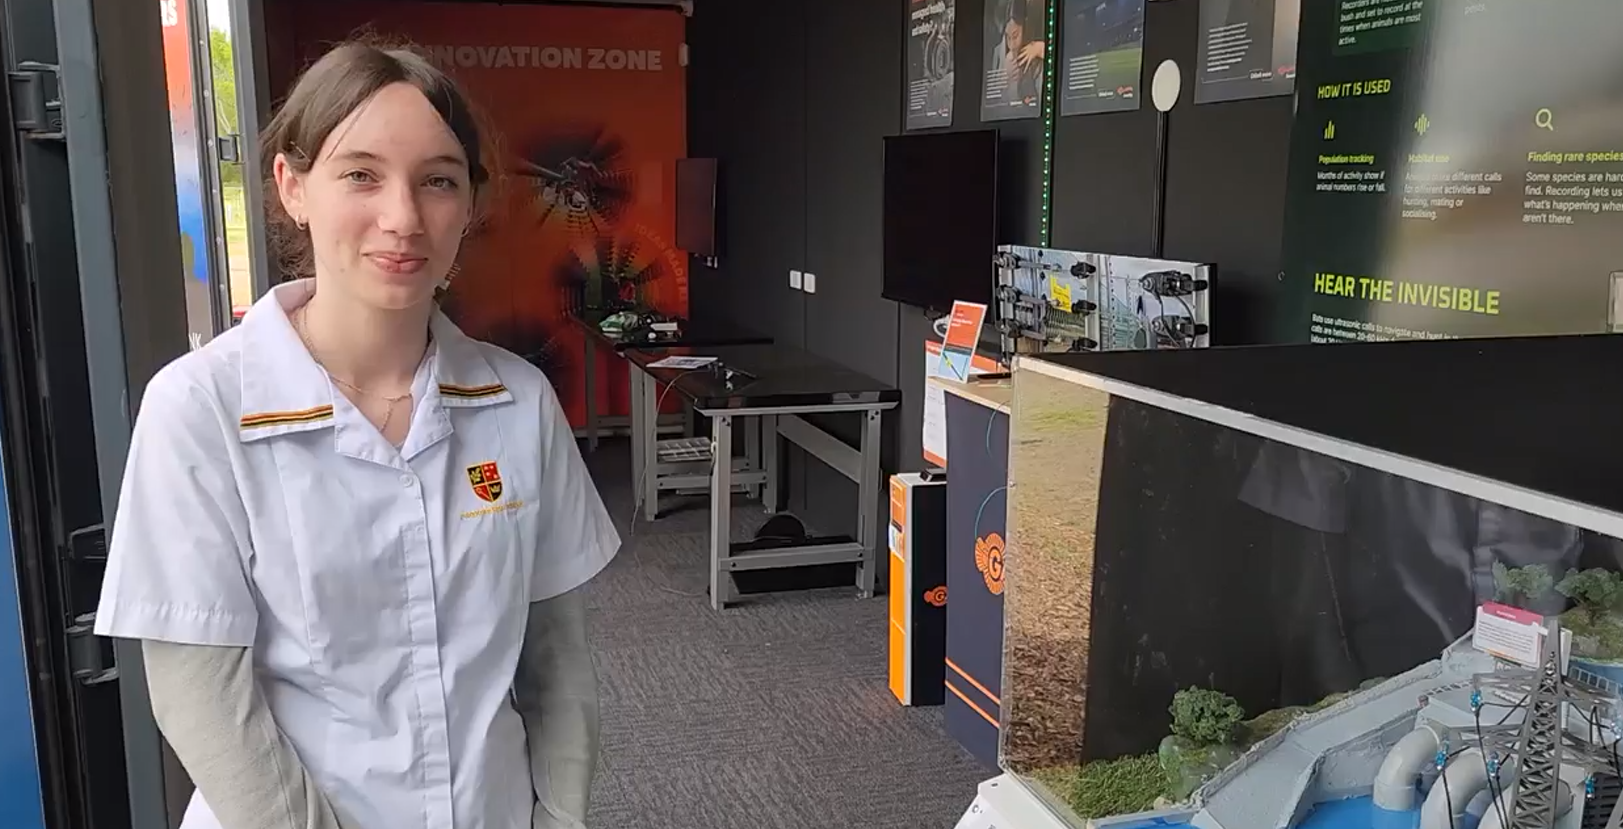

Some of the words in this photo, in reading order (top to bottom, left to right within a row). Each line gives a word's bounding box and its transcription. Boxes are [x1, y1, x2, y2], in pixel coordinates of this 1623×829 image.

[1355, 10, 1366, 20] and
[1367, 9, 1376, 17] set
[1384, 4, 1404, 14] record
[1404, 2, 1411, 11] at
[1412, 1, 1423, 9] the
[1340, 25, 1354, 33] times
[1356, 22, 1370, 31] when
[1371, 18, 1393, 28] animals
[1394, 17, 1404, 25] are
[1406, 13, 1421, 22] most
[424, 45, 582, 69] NOVATION
[588, 49, 662, 71] ZONE
[1317, 84, 1341, 99] HOW
[1342, 82, 1352, 97] IT
[1353, 82, 1362, 96] IS
[1364, 79, 1391, 94] USED
[1319, 155, 1349, 165] Population
[1349, 155, 1374, 165] tracking
[1528, 151, 1562, 164] Finding
[1564, 153, 1584, 161] rare
[1586, 150, 1623, 163] species
[1317, 171, 1336, 180] Months
[1337, 171, 1343, 180] of
[1344, 171, 1362, 181] activity
[1364, 171, 1379, 180] show
[1452, 170, 1483, 181] different
[1484, 172, 1502, 182] calls
[1526, 172, 1550, 182] Some
[1552, 172, 1586, 183] species
[1588, 174, 1603, 182] are
[1316, 183, 1333, 191] animal
[1334, 183, 1356, 192] numbers
[1357, 183, 1367, 192] rise
[1375, 182, 1385, 192] fall.
[1445, 185, 1476, 195] activities
[1478, 186, 1492, 195] like
[1525, 186, 1543, 196] find.
[1545, 186, 1590, 199] Recording
[1592, 187, 1609, 197] lets
[1611, 188, 1623, 197] us
[1430, 198, 1454, 209] mating
[1524, 200, 1550, 210] what's
[1552, 200, 1600, 213] happening
[1522, 214, 1546, 223] aren't
[1548, 214, 1574, 224] there.
[1314, 273, 1355, 297] HEAR
[1359, 278, 1394, 302] THE
[1398, 281, 1500, 315] INVISIBLE
[1311, 325, 1323, 334] calls
[1323, 328, 1332, 336] are
[1332, 328, 1356, 339] between
[1324, 318, 1333, 326] use
[1335, 319, 1360, 330] ultrasonic
[1361, 323, 1375, 332] calls
[1384, 326, 1411, 338] navigate
[1411, 331, 1425, 339] and
